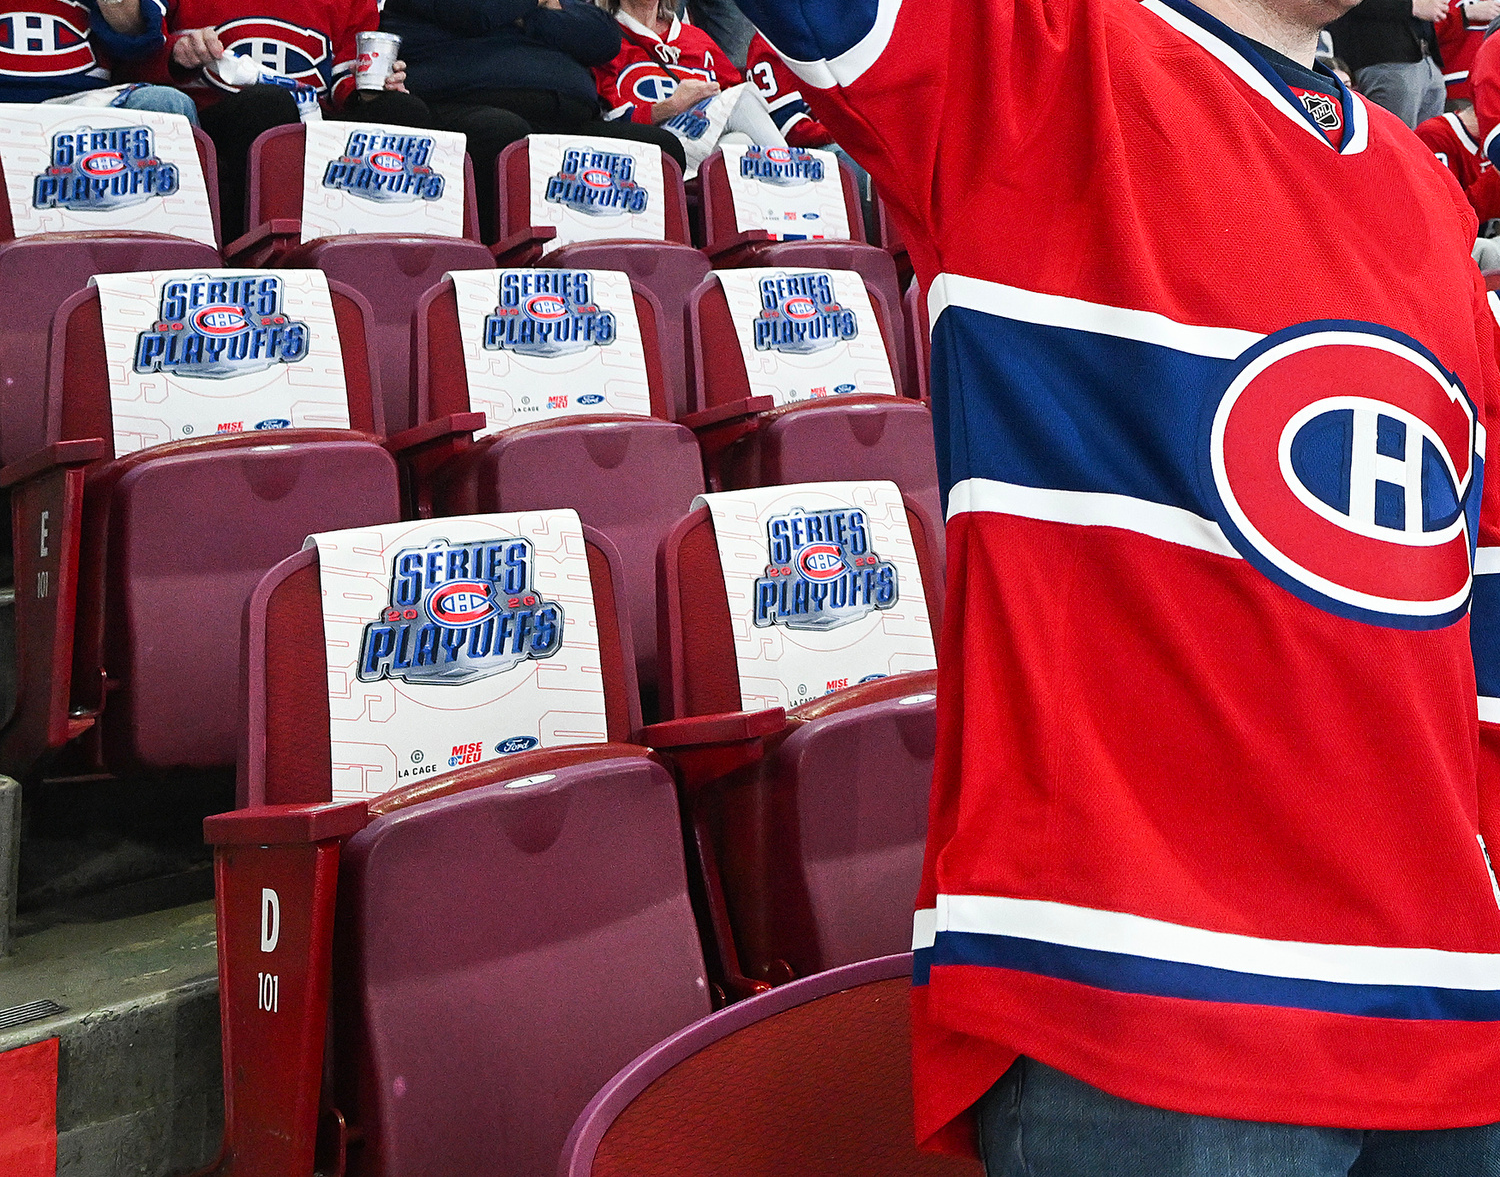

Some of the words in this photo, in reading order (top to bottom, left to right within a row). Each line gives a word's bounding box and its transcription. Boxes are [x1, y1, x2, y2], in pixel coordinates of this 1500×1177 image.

[37, 166, 176, 204] PLAYOFFS
[325, 163, 443, 200] PLAYOFFS
[741, 157, 824, 180] PLAYOFFS
[549, 179, 646, 211] PLAYOFFS
[487, 311, 613, 346] PLAYOFFS
[756, 311, 854, 349] PLAYOFFS
[139, 324, 306, 368] PLAYOFFS
[548, 395, 568, 403] MISE
[217, 420, 244, 431] MISE
[40, 510, 49, 558] E
[37, 570, 49, 599] 101
[758, 565, 896, 621] PLAYOFFS
[387, 608, 418, 622] 20
[363, 606, 559, 675] PLAYOFFS
[826, 678, 849, 690] MISE
[451, 741, 483, 757] MISE
[457, 751, 482, 766] JEU
[398, 770, 410, 778] LA
[412, 764, 437, 776] CAGE
[261, 887, 280, 953] D
[258, 971, 279, 1014] 101
